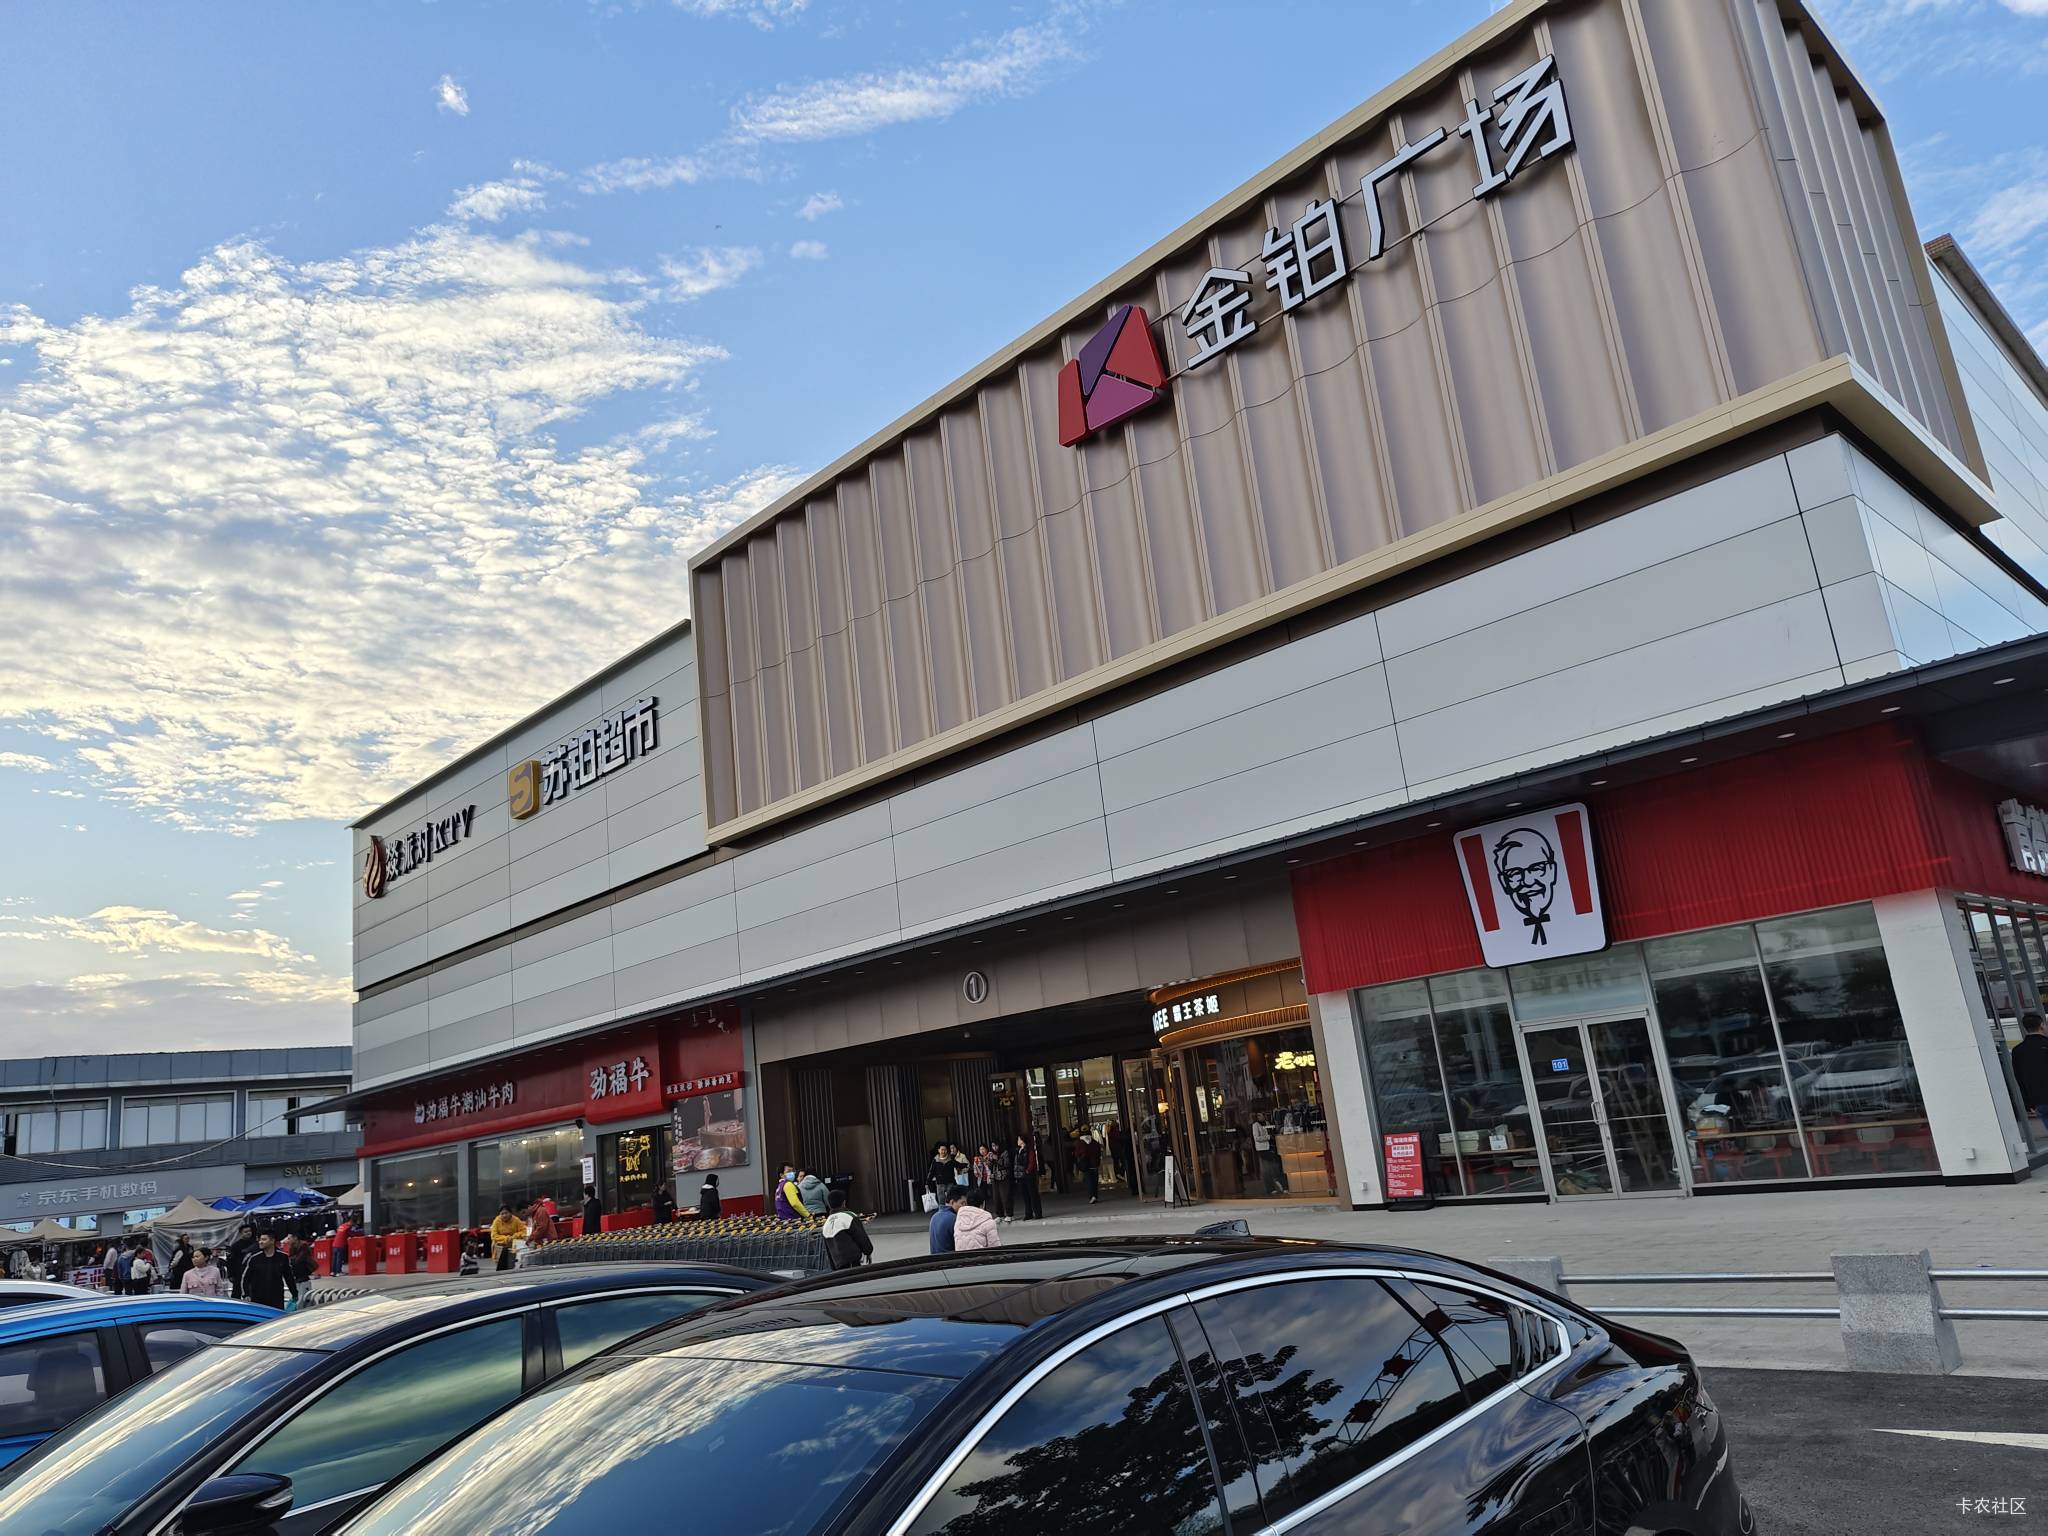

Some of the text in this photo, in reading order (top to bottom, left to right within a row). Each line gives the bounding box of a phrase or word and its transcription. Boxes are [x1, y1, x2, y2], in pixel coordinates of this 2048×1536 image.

[1181, 54, 1576, 370] 金铂广场
[541, 697, 660, 805] 苏铂超市
[1172, 995, 1219, 1022] 霸王茶姬
[590, 1056, 650, 1101] 劲福牛
[1553, 1061, 1567, 1069] 101
[425, 1081, 514, 1122] 劲福牛潮汕牛肉
[37, 1181, 157, 1206] 京东手机数码
